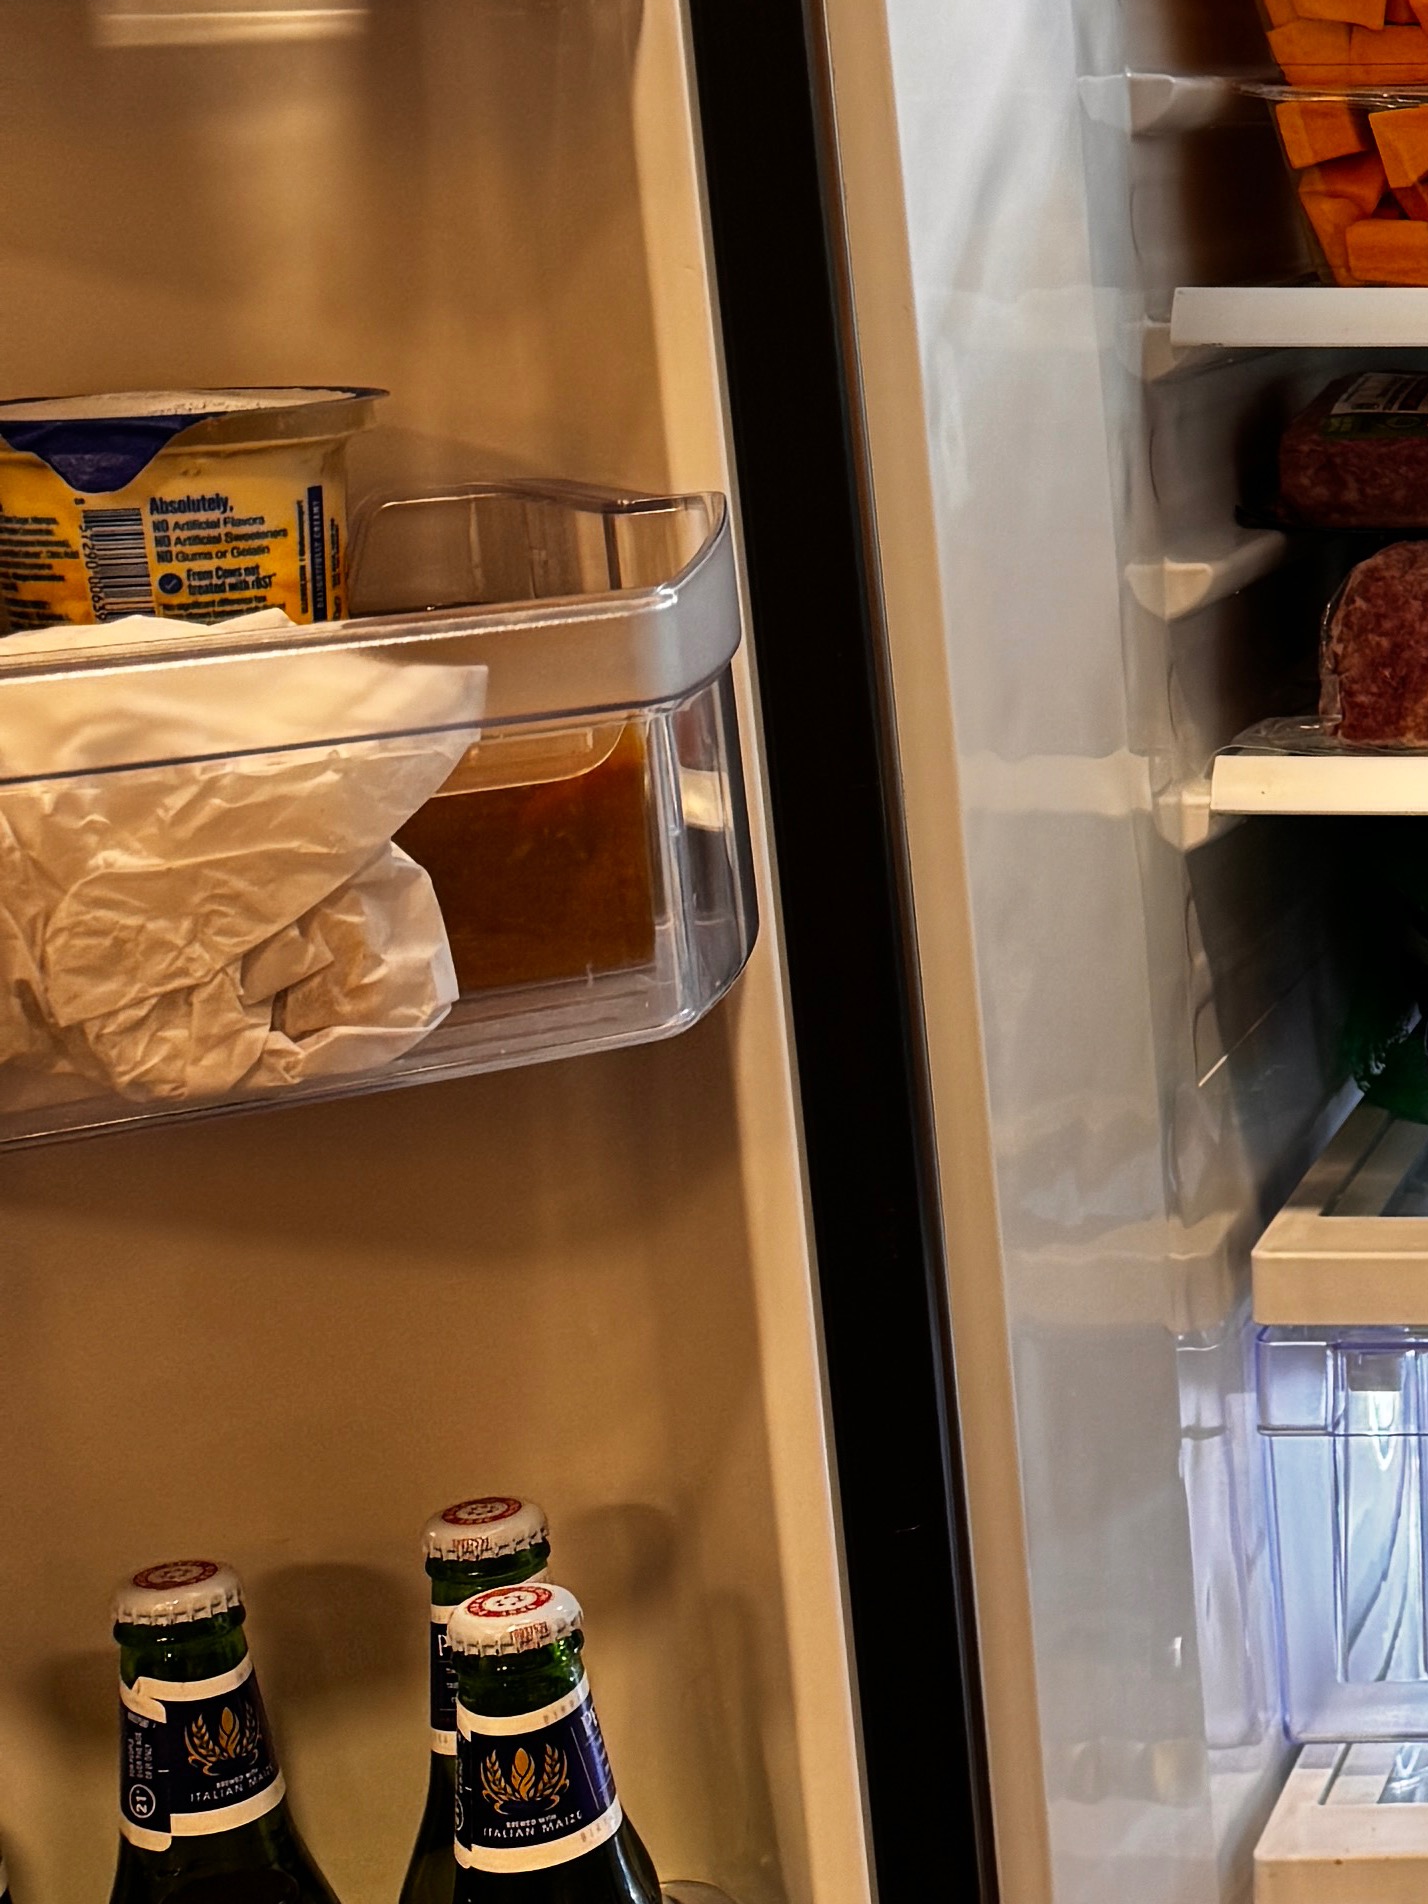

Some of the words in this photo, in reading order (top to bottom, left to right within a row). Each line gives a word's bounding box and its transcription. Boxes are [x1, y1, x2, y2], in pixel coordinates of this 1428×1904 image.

[152, 519, 169, 532] NO
[173, 518, 220, 532] Artificial
[223, 515, 265, 528] Flavors
[154, 535, 171, 548] NO
[174, 532, 222, 547] Artificial
[156, 550, 173, 563] NO
[176, 551, 213, 563] Gums
[215, 551, 228, 560] or
[231, 545, 270, 558] Gelatin
[190, 1784, 244, 1802] ITALIAN
[483, 1826, 535, 1839] ITALIAN
